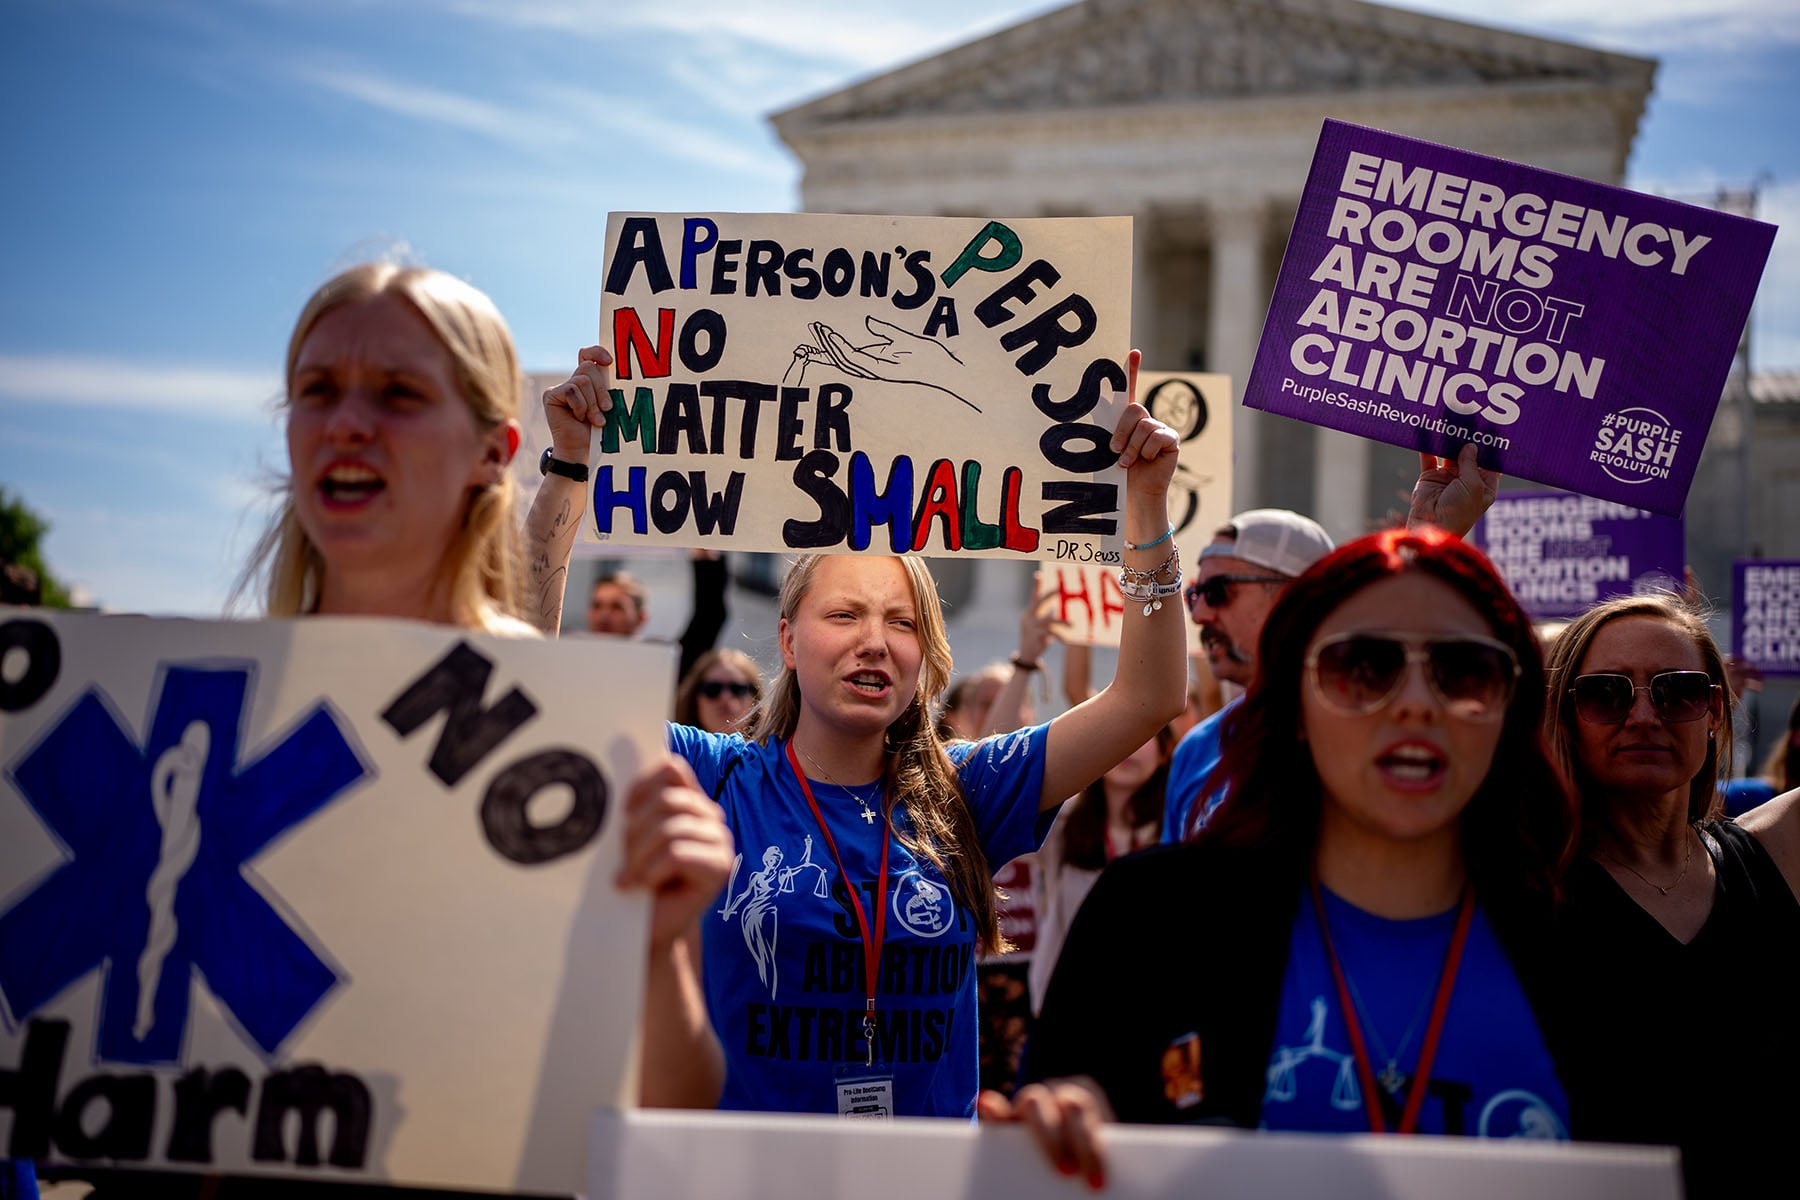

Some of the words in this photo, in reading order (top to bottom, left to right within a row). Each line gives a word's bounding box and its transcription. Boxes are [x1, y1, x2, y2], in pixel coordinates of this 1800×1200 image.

[604, 217, 675, 295] A
[1326, 196, 1559, 289] ROOMS
[1339, 151, 1713, 276] EMERGENCY
[679, 217, 936, 310] PERSON'S
[1310, 245, 1438, 309] ARE
[1445, 274, 1584, 344] NOT
[613, 306, 727, 380] NO
[922, 296, 960, 338] A
[1296, 289, 1605, 400] ABORTION
[600, 380, 853, 462] MATTER
[940, 220, 1128, 536] PERSON
[1281, 377, 1511, 451] PurpleSashRevolution.com
[1290, 334, 1525, 426] CLINICS
[1589, 450, 1670, 480] REVOLUTION
[1594, 427, 1678, 468] SASH
[1601, 412, 1682, 445] #PURPLE
[593, 465, 746, 536] HOW
[782, 450, 1040, 554] SMALL
[1079, 542, 1120, 563] Seuss
[377, 638, 611, 868] NO
